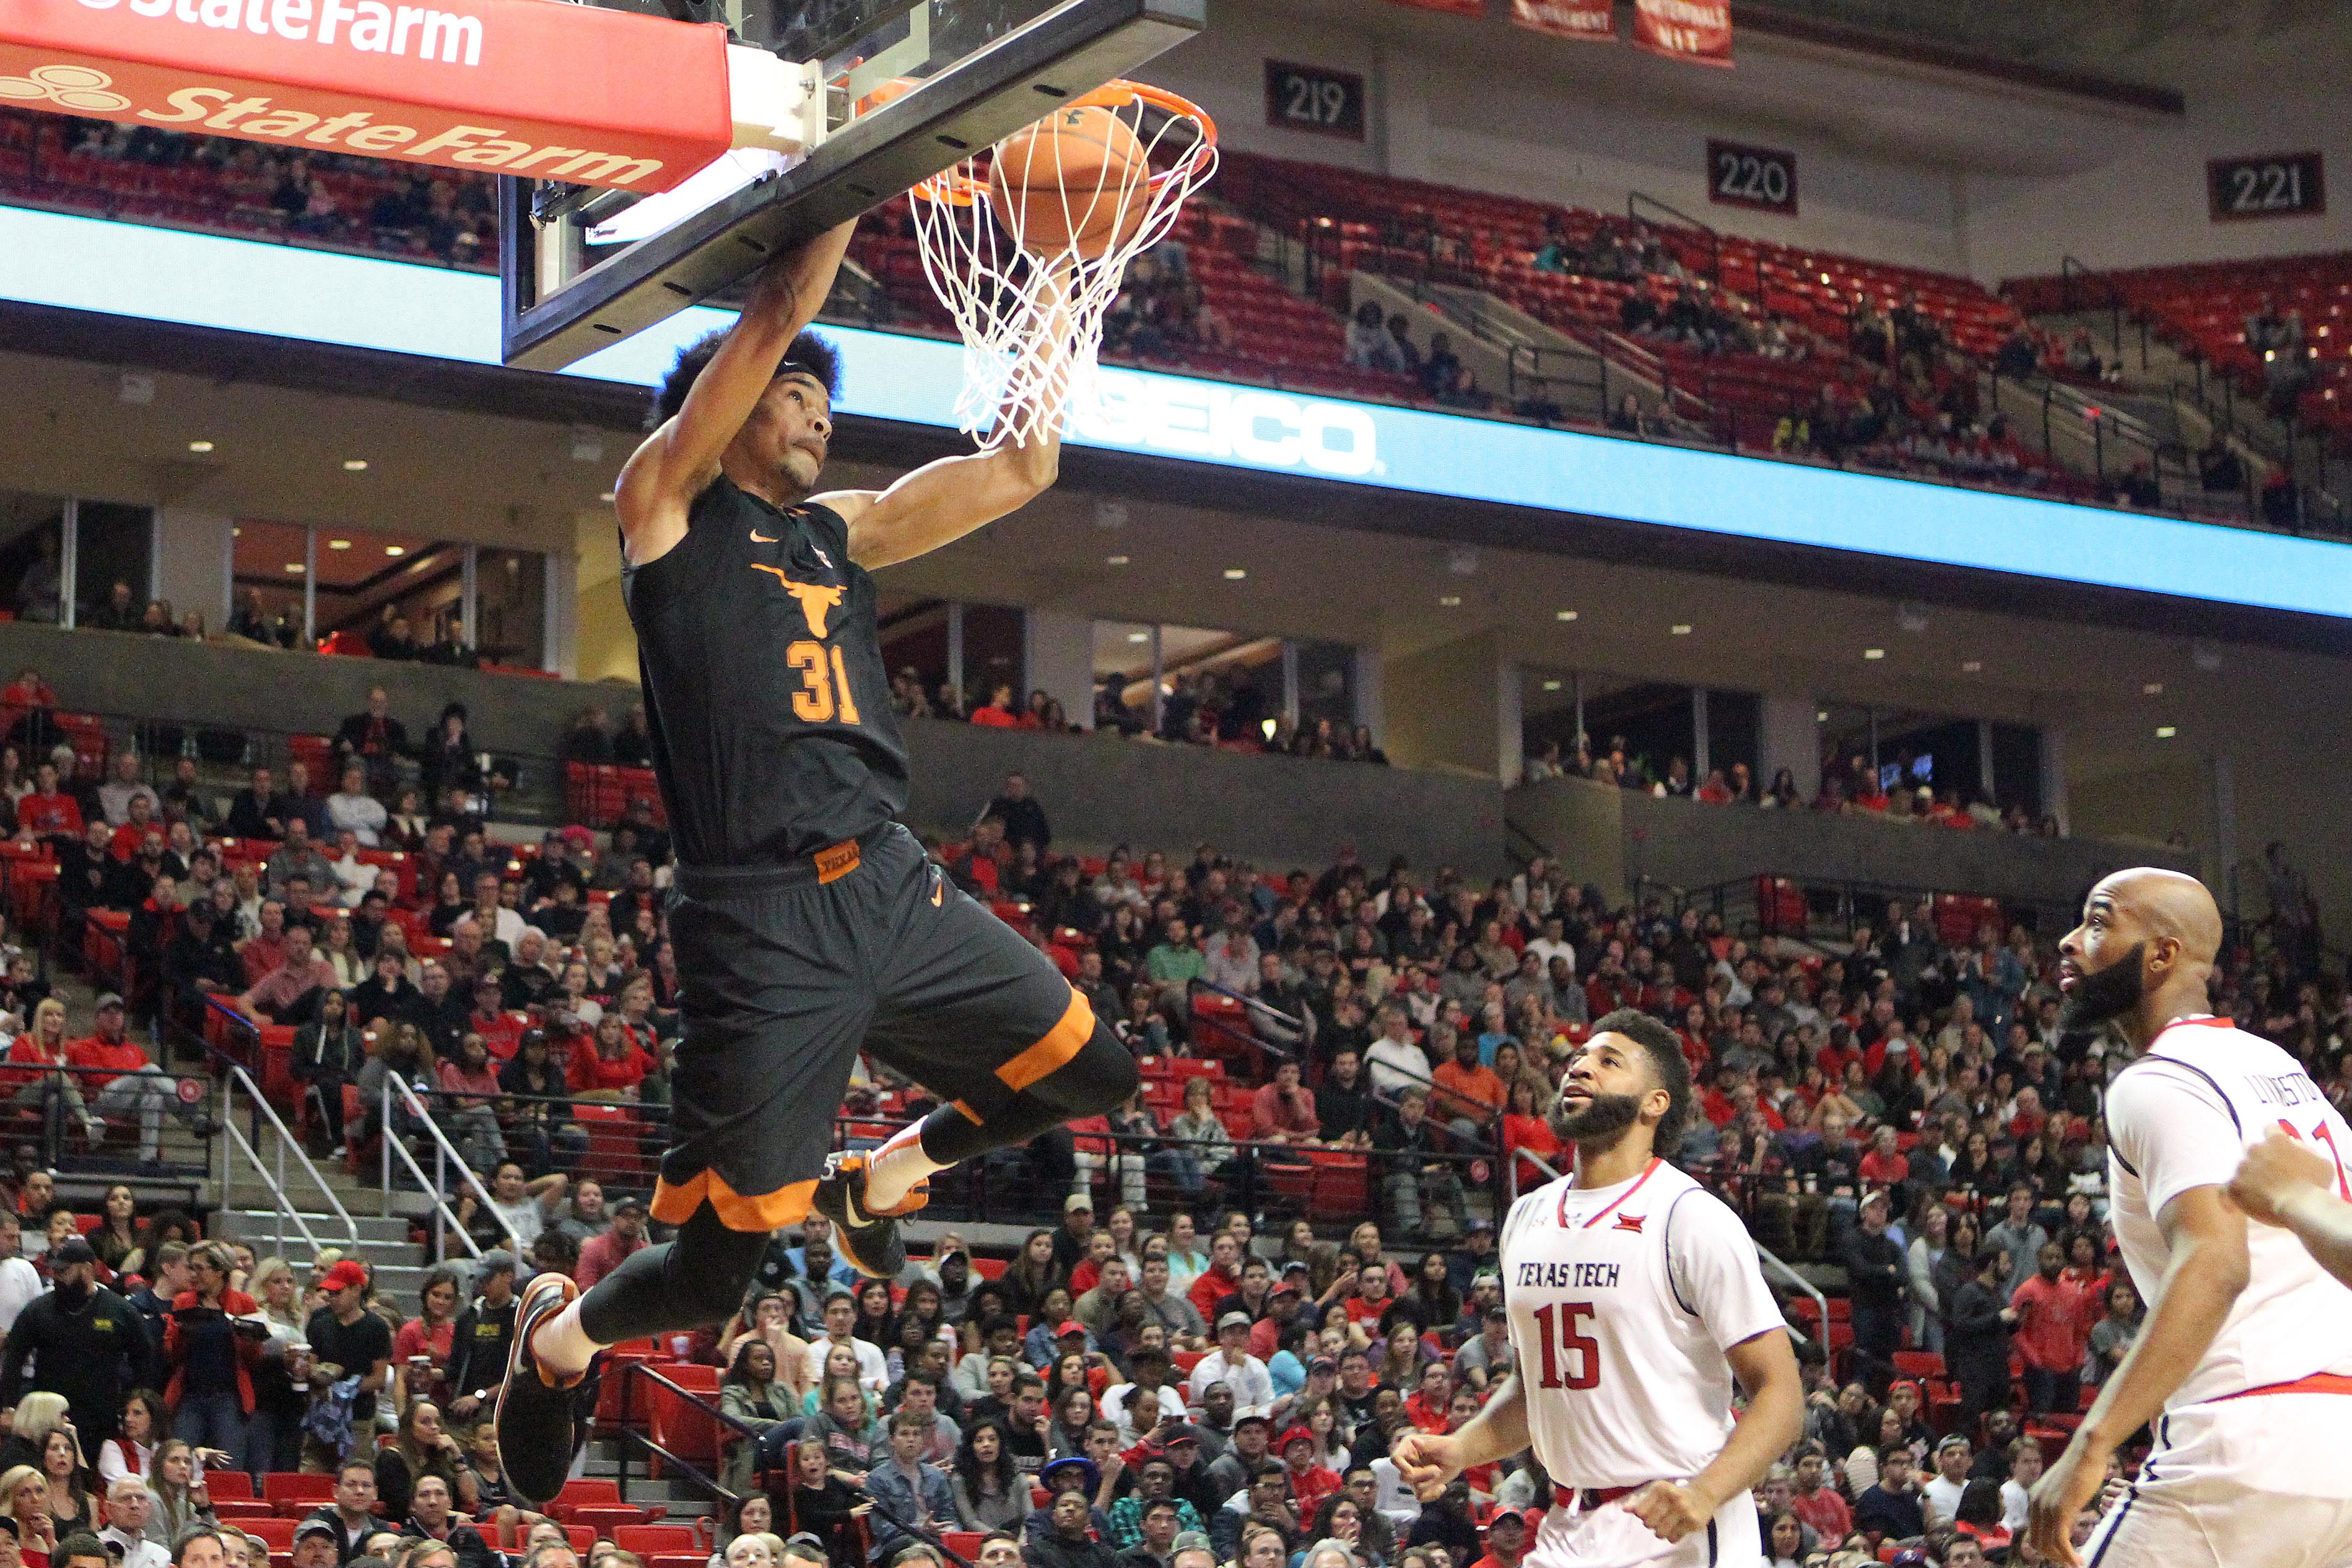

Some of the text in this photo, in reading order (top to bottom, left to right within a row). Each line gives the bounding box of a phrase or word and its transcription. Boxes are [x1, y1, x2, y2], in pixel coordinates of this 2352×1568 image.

[317, 0, 484, 66] Farm
[1286, 76, 1344, 123] 219
[137, 87, 664, 184] State Farm
[1720, 152, 1788, 203] 220
[2232, 163, 2301, 209] 221
[786, 640, 861, 725] 31
[1517, 1262, 1621, 1287] TEXAS TECH
[1533, 1302, 1600, 1390] 15
